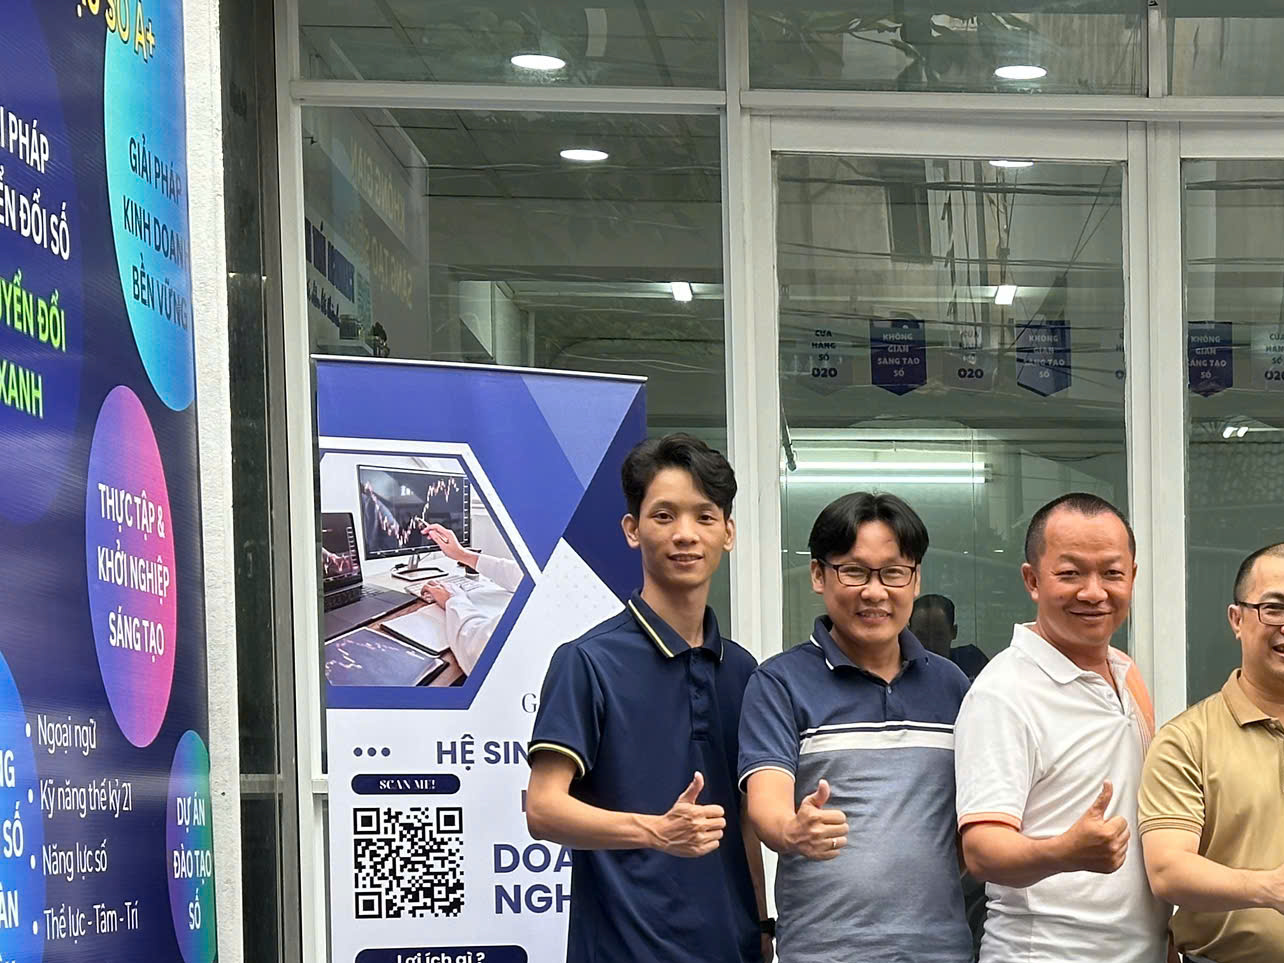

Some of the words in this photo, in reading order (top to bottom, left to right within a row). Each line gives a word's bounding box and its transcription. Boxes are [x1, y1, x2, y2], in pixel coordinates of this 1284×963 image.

[8, 112, 50, 173] PHÁP
[129, 134, 152, 184] GIẢI
[154, 156, 182, 205] PHÁP
[19, 188, 48, 248] ĐỔI
[50, 202, 70, 260] SỐ
[123, 195, 151, 247] KINH
[132, 253, 155, 311] BỀN
[157, 278, 188, 331] VỮNG
[37, 289, 66, 352] ĐỔI
[98, 483, 133, 532] THỰC
[134, 490, 155, 540] TẬP
[157, 505, 165, 538] &
[98, 539, 127, 586] KHỞI
[130, 555, 169, 604] NGHIỆP
[108, 606, 141, 651] SÁNG
[142, 620, 164, 663] TẠO
[38, 714, 72, 755] Ngoại
[74, 718, 97, 756] ngữ
[436, 734, 475, 770] HỆ
[40, 779, 55, 818] Kỹ
[58, 780, 86, 818] năng
[88, 778, 107, 811] thế
[108, 779, 121, 818] kỷ
[122, 782, 132, 811] 21
[379, 779, 410, 790] SCAN
[414, 779, 436, 790] ME!
[3, 801, 24, 858] SỐ
[176, 797, 191, 833] DỰ
[193, 792, 206, 827] ÁN
[42, 843, 73, 882] Năng
[76, 842, 93, 880] lực
[95, 839, 107, 872] số
[173, 843, 193, 879] ĐÀO
[194, 850, 212, 885] TẠO
[44, 904, 66, 940] Thể
[68, 908, 86, 944] lực
[93, 902, 118, 936] Tâm
[124, 900, 139, 931] Trí
[188, 890, 201, 930] SỐ
